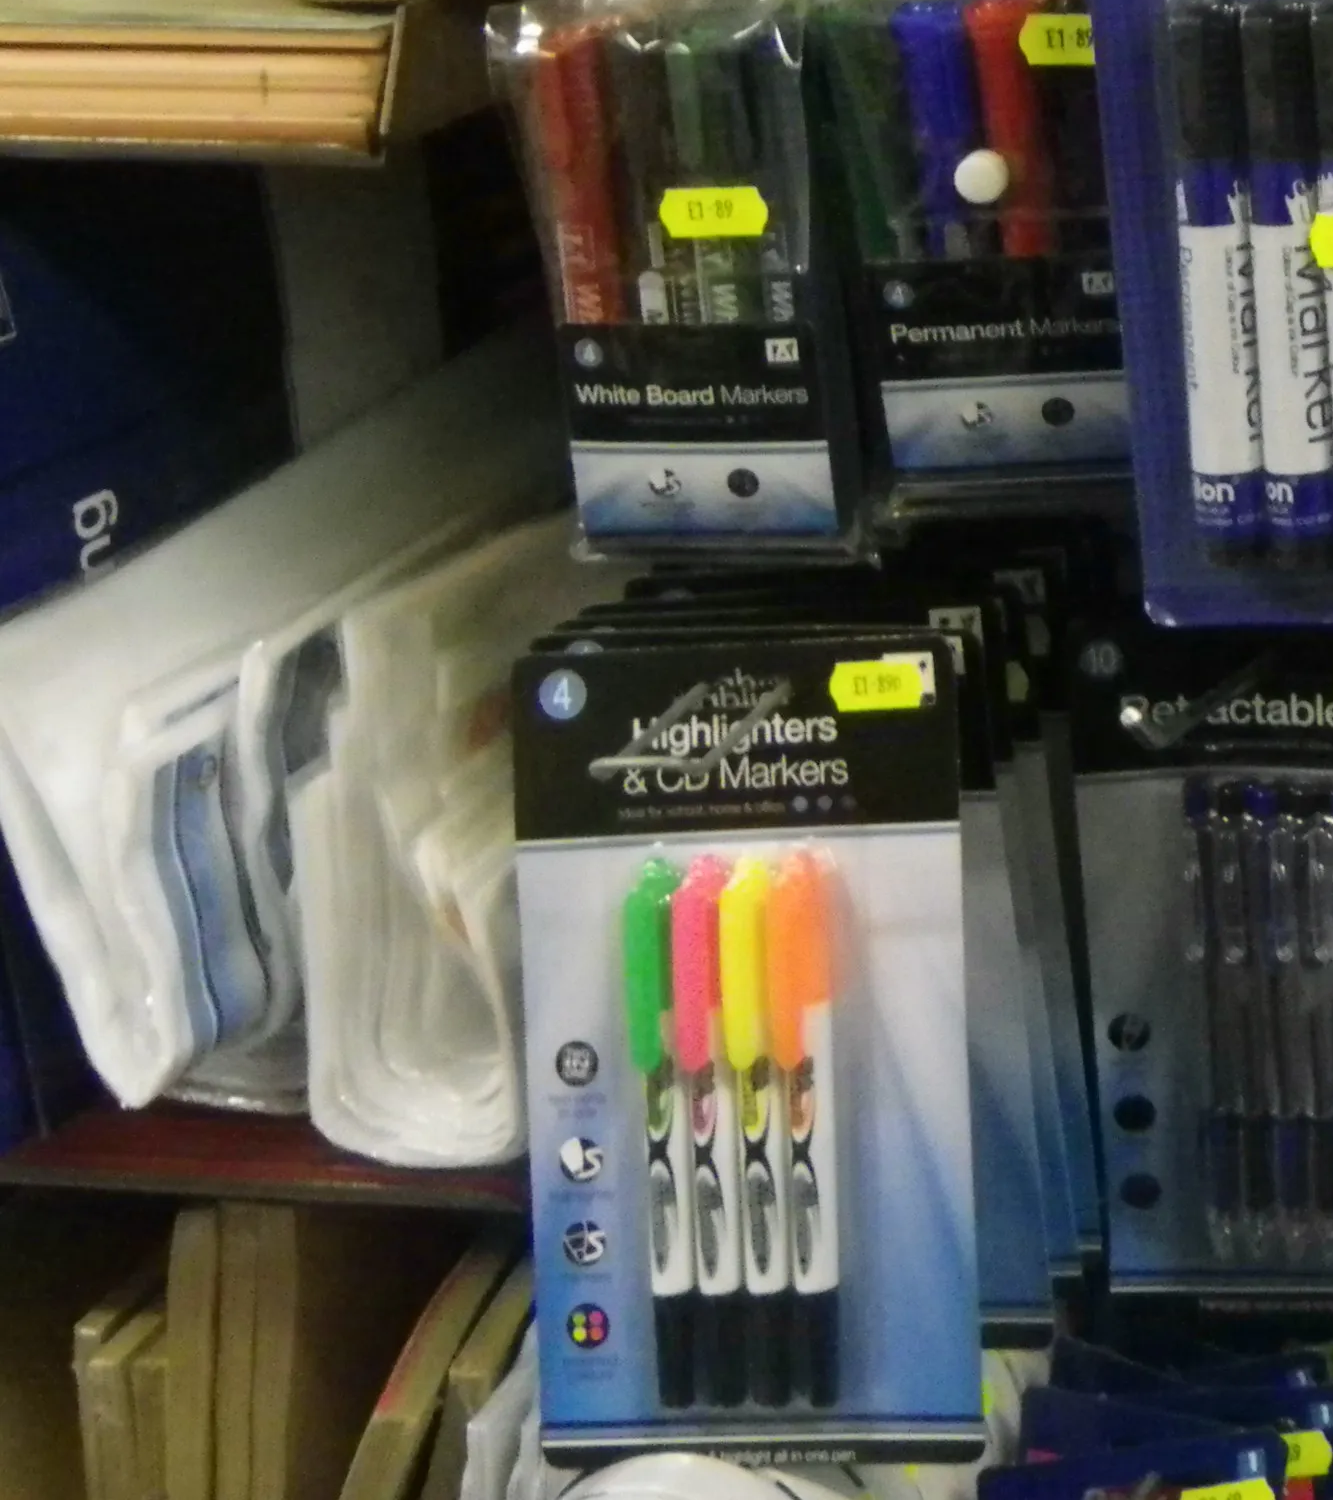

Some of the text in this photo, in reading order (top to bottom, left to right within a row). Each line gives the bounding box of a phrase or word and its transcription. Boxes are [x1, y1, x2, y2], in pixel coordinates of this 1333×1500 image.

[890, 320, 1024, 344] Permanent
[575, 382, 809, 406] White Board Markers
[552, 677, 570, 711] 4
[624, 753, 849, 795] & CD Markers
